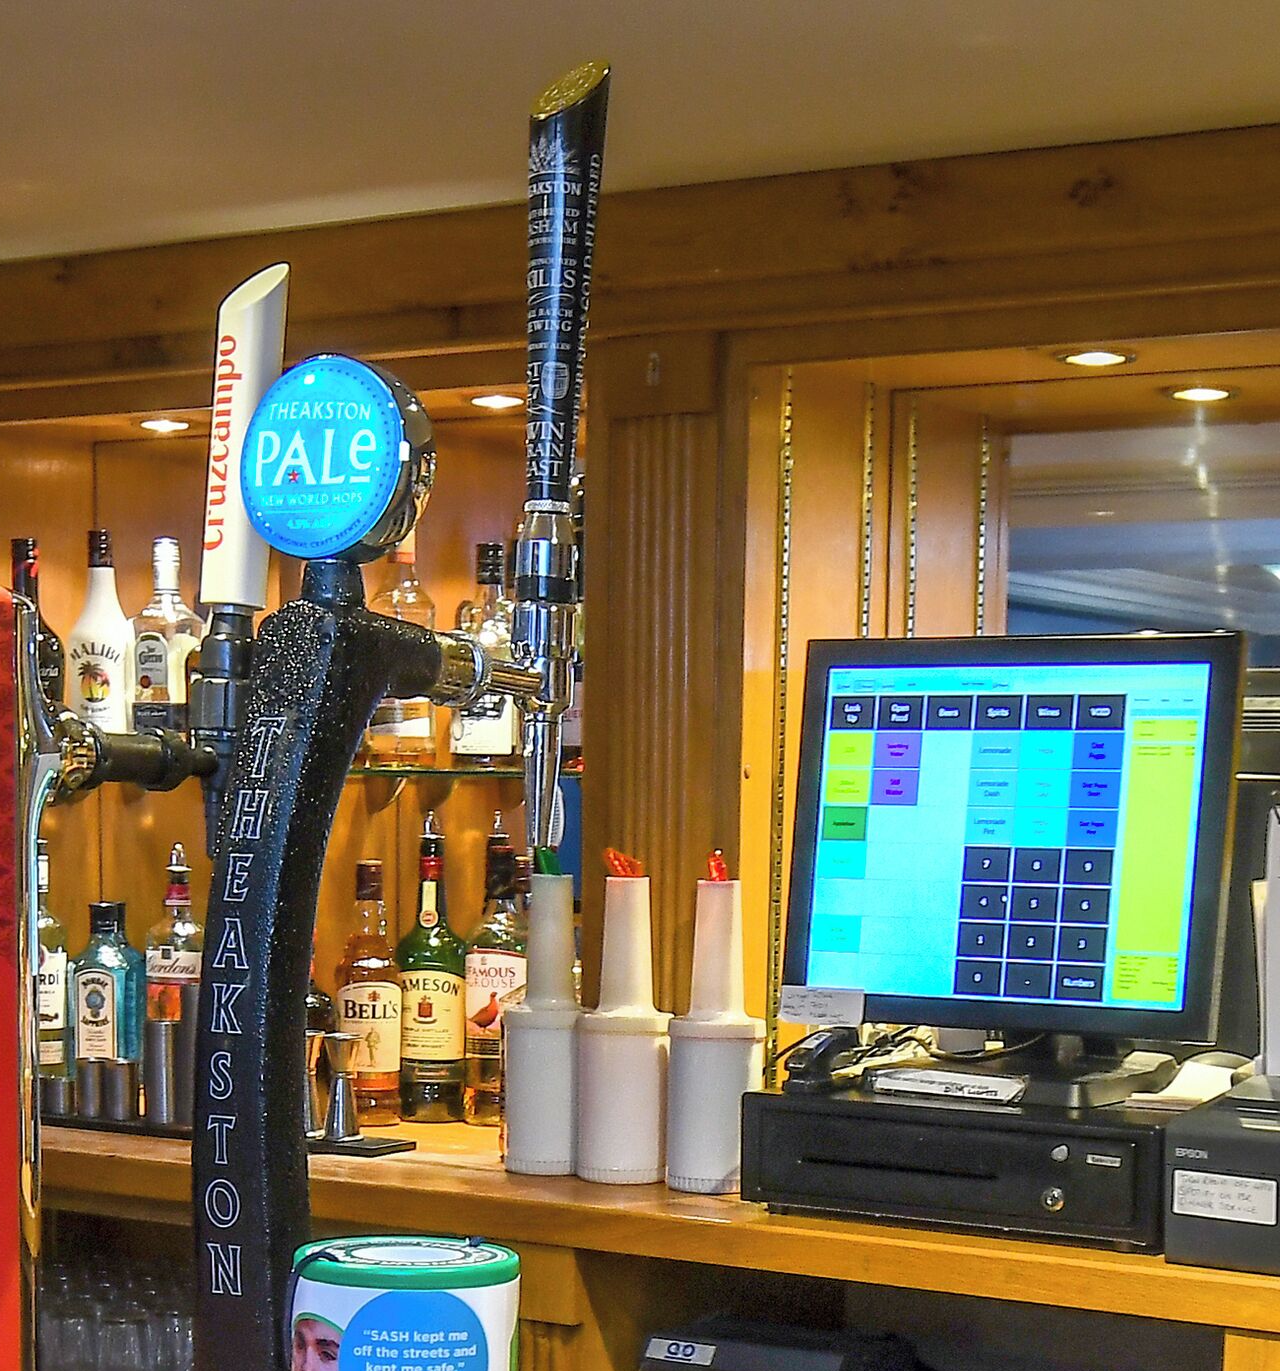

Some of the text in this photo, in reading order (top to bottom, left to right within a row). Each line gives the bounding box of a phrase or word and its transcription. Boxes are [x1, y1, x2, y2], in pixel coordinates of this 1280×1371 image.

[528, 181, 582, 196] EAKSTON
[526, 269, 577, 289] KILLS
[527, 319, 572, 333] EWING
[269, 401, 372, 421] THEAKSTON
[287, 493, 329, 506] WORLD
[333, 492, 363, 505] HOPS
[39, 664, 59, 678] aria
[982, 859, 1092, 871] 7 8 9
[1030, 899, 1039, 908] 5
[148, 955, 197, 974] Gordon's
[466, 965, 516, 978] FAMOUS
[401, 978, 461, 997] AMESON
[205, 714, 287, 1299] THEAKSTON
[344, 999, 399, 1020] BELL'S
[1175, 1148, 1209, 1159] EPSON
[413, 1330, 445, 1344] kept
[448, 1331, 469, 1341] me
[353, 1345, 477, 1359] off the streets and
